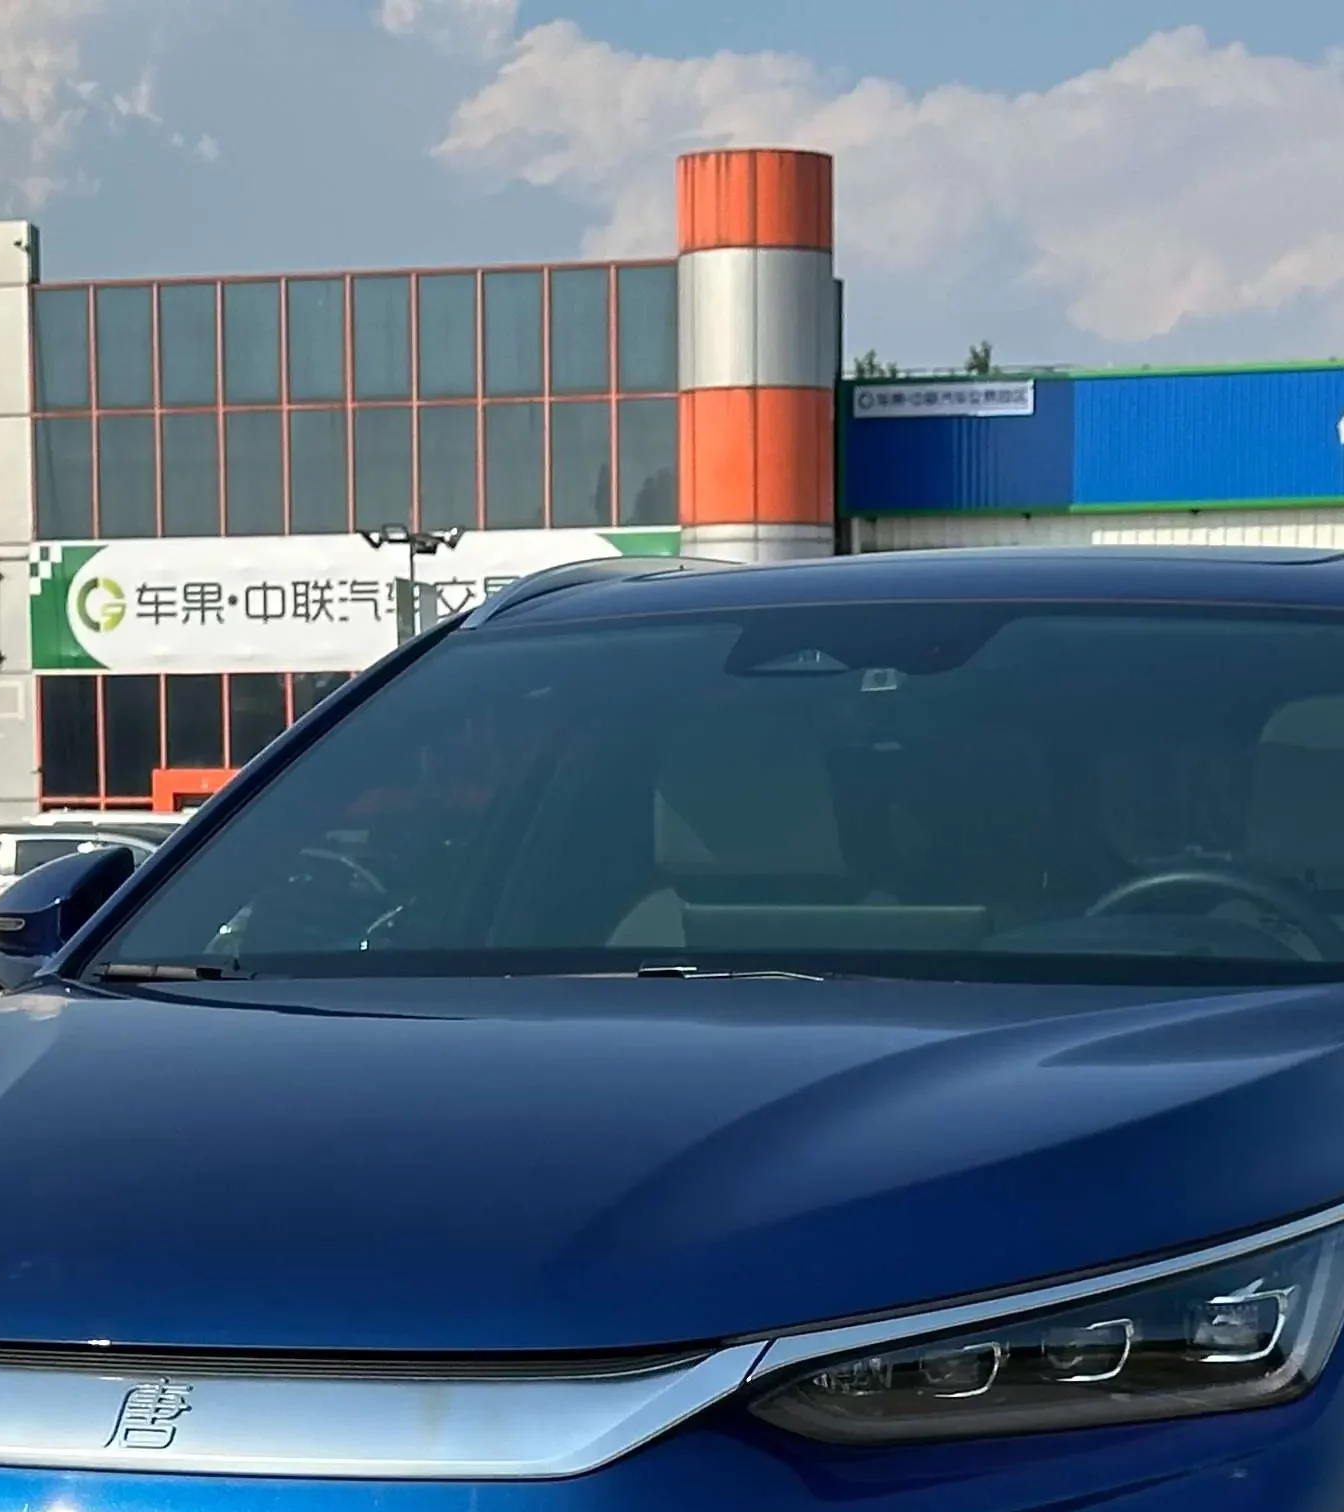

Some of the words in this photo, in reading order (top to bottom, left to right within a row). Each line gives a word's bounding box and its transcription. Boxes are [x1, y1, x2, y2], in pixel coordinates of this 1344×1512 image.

[134, 576, 520, 626] 车果·中联汽交
